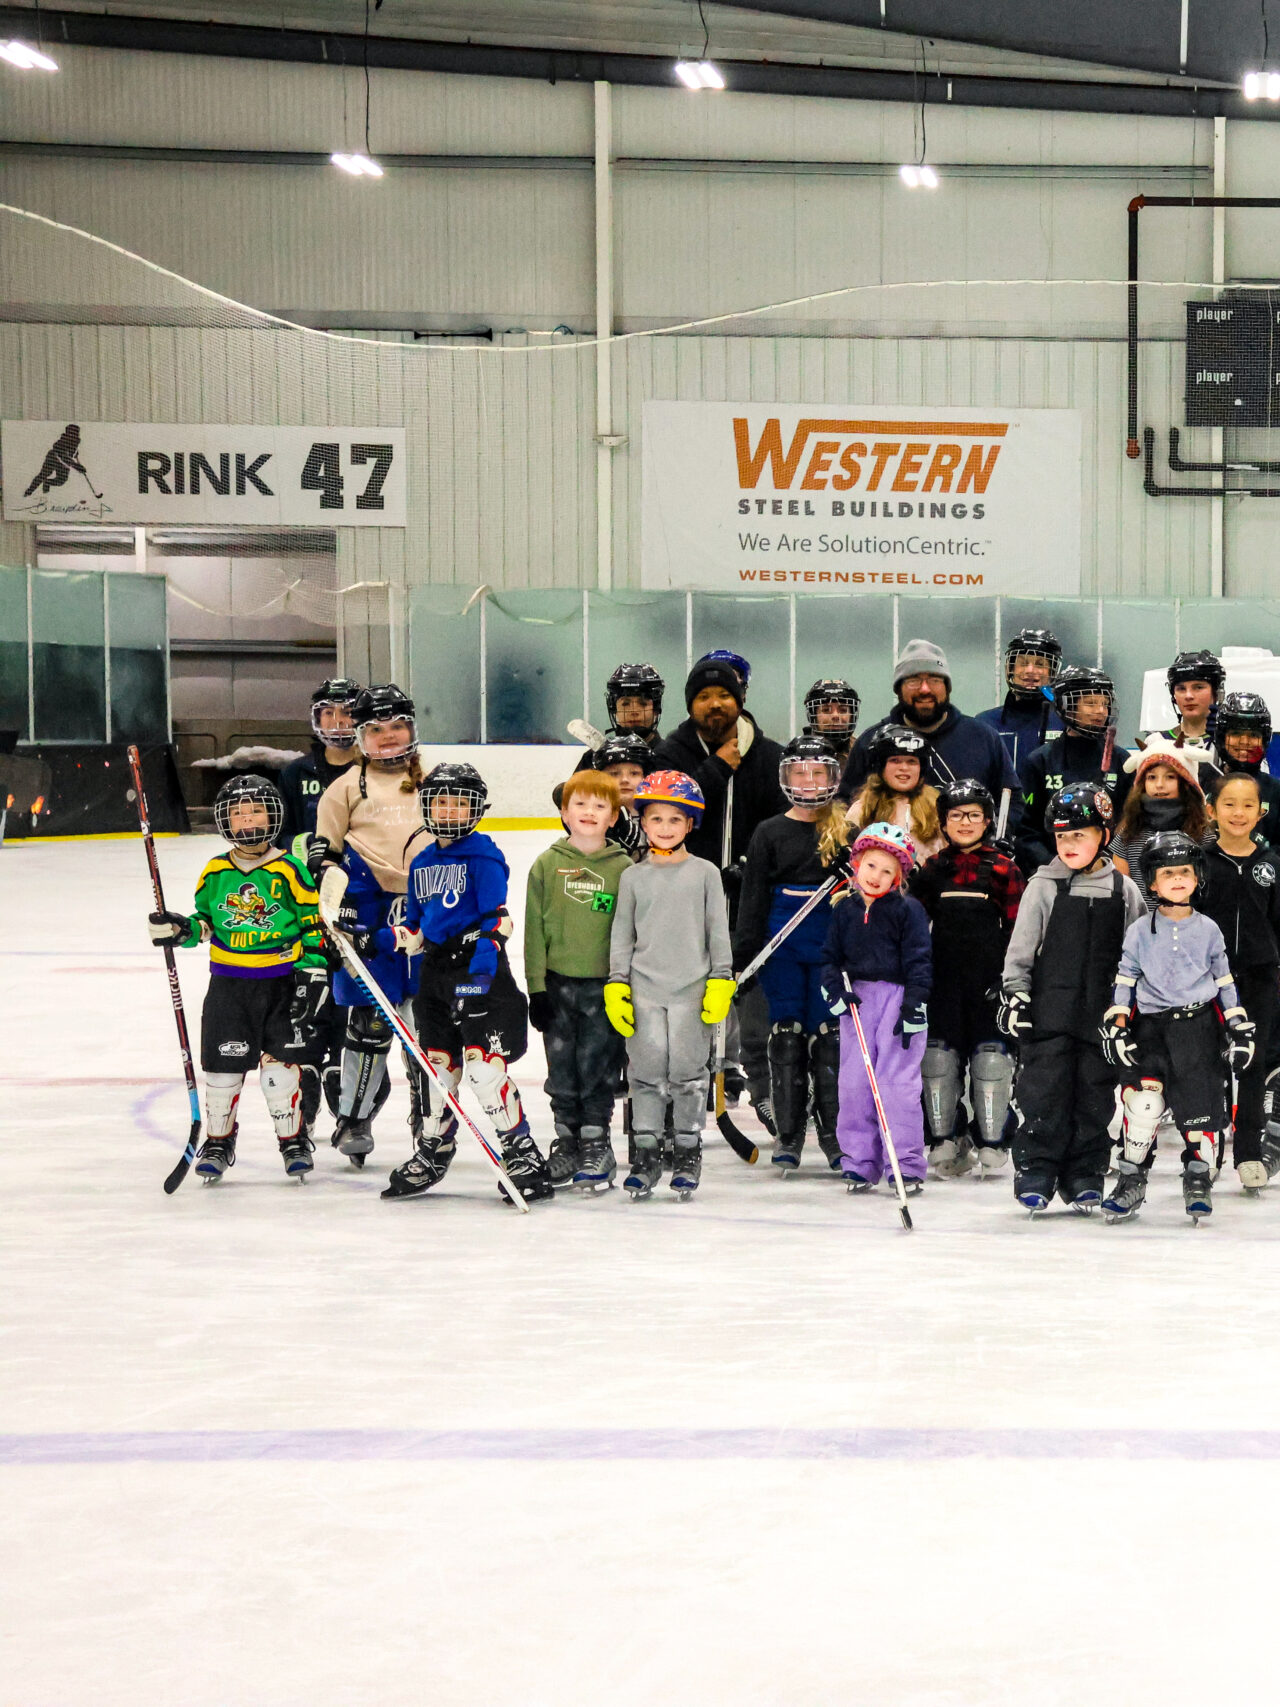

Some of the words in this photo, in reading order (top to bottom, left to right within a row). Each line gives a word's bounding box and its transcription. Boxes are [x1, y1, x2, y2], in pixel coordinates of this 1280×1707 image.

[1197, 307, 1233, 321] player
[1197, 369, 1233, 383] player
[732, 417, 1009, 494] WESTERN
[137, 451, 274, 496] RINK
[300, 443, 393, 510] 47
[738, 498, 816, 516] STEEL
[832, 500, 985, 520] BUILDINGS
[738, 533, 771, 553] We
[777, 534, 812, 553] Are
[738, 569, 984, 586] WESTERNSTEEL.COM
[301, 780, 320, 795] 10
[1045, 775, 1064, 790] 23
[270, 879, 282, 899] C
[230, 930, 282, 948] DUCKS
